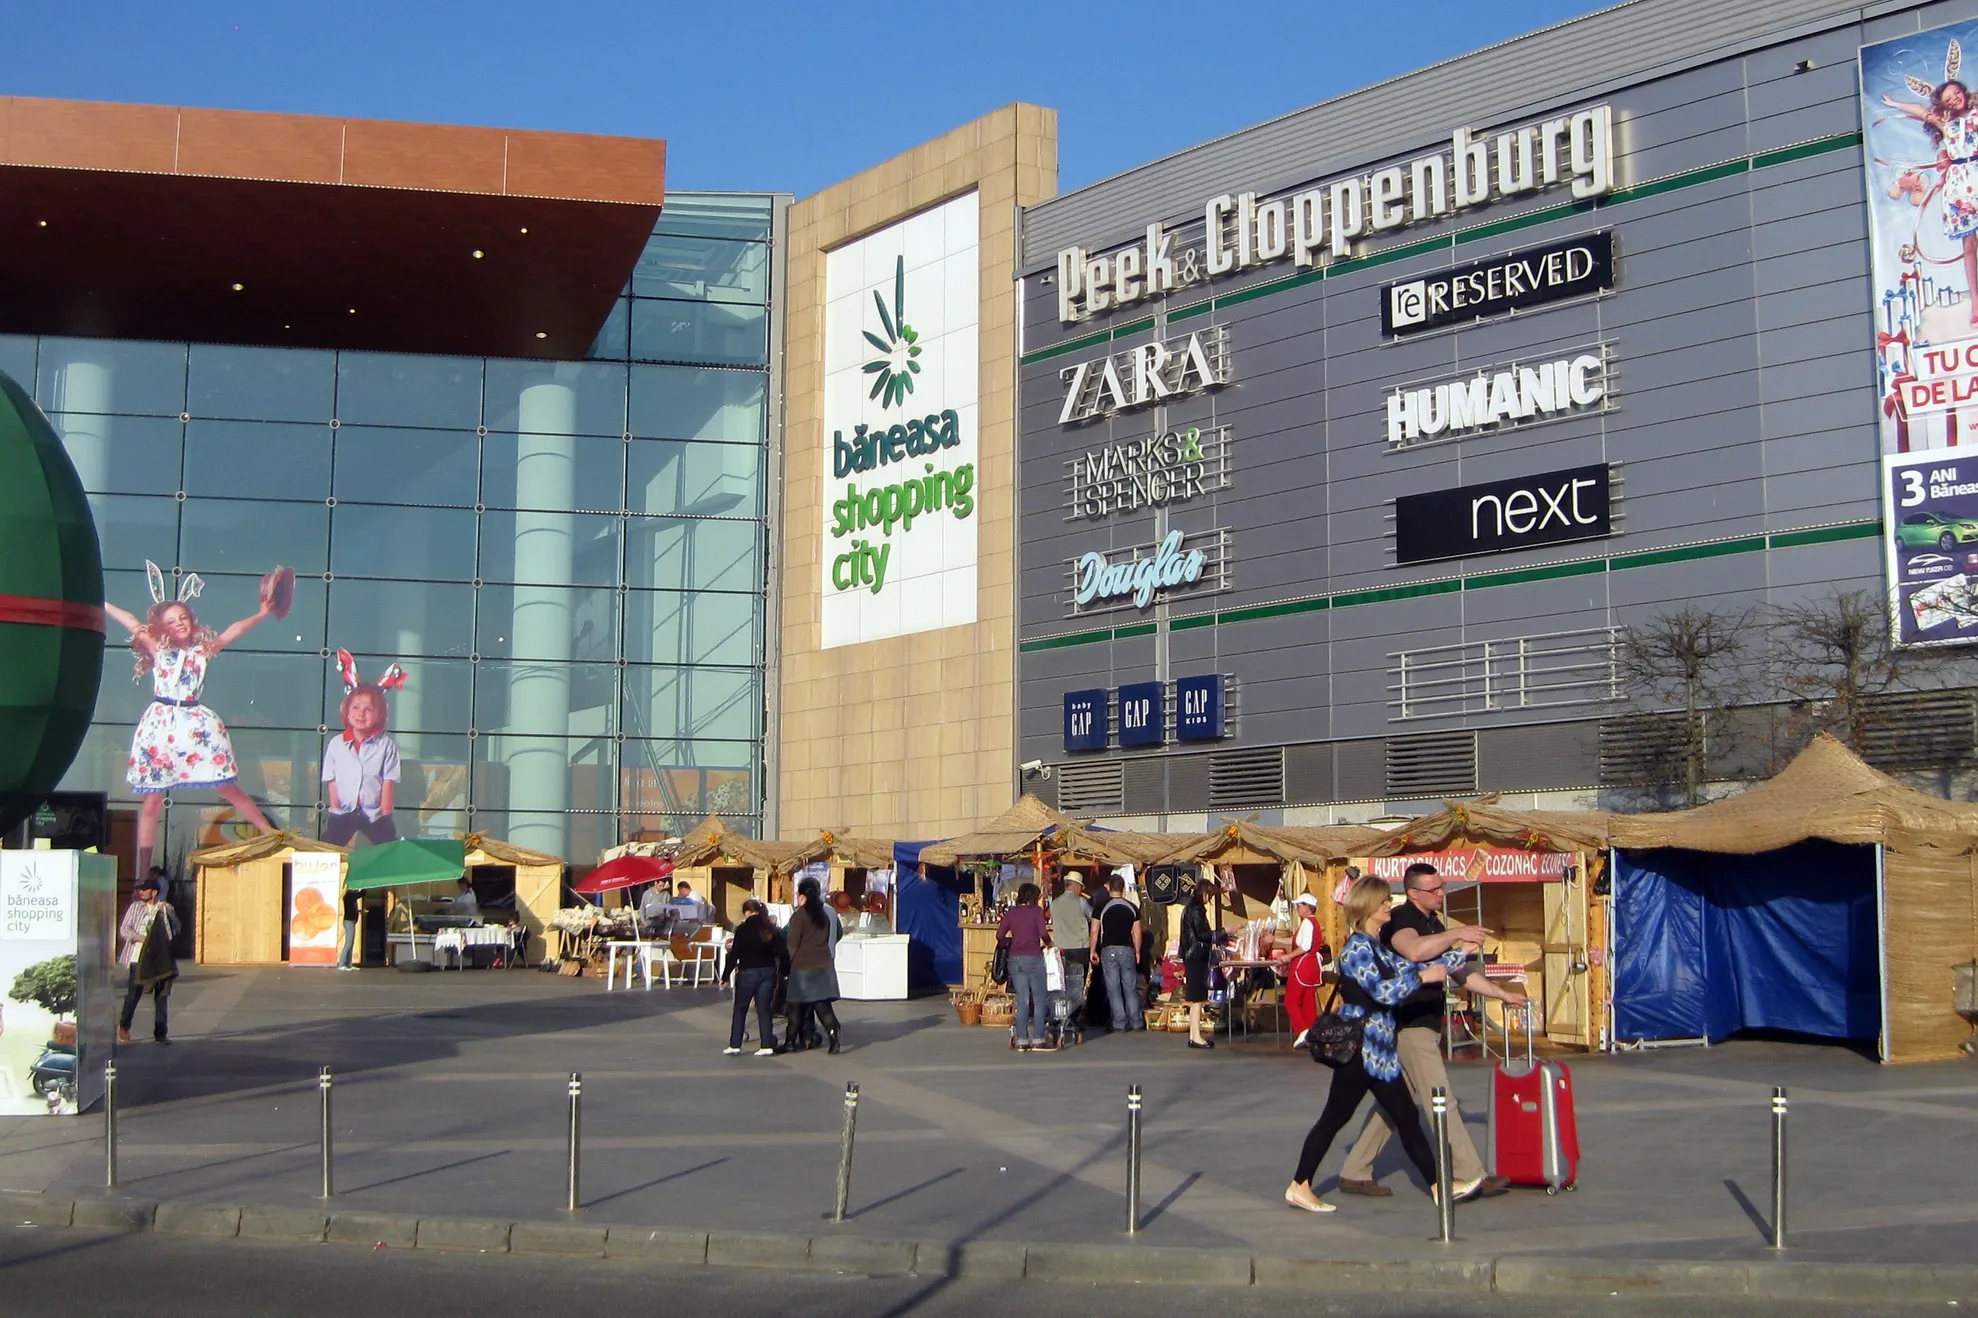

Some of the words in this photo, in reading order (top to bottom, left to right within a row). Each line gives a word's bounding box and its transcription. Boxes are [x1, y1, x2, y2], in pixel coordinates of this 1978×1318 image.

[1058, 222, 1177, 322] Peek
[1183, 248, 1200, 282] &
[1206, 105, 1613, 276] Cloppenburg
[1429, 247, 1593, 315] RESERVED
[1923, 348, 1959, 374] TU
[1058, 333, 1221, 424] ZARA
[1912, 382, 1946, 408] DE
[1387, 355, 1603, 442] HUMANIC
[834, 409, 960, 478] băneasa
[1085, 463, 1206, 516] SPENCER
[1900, 470, 1926, 507] 3
[1929, 467, 1957, 484] ANI
[831, 463, 974, 536] shopping
[1472, 478, 1598, 539] next
[832, 540, 890, 594] city
[1077, 530, 1207, 608] Douglas
[1125, 699, 1150, 729] GAP
[1185, 689, 1208, 715] GAP
[1072, 711, 1092, 737] GAP
[1185, 716, 1208, 725] KIDS
[1485, 853, 1538, 876] COZONAC
[7, 894, 59, 906] băneasa
[7, 907, 63, 922] shopping
[7, 920, 31, 934] city
